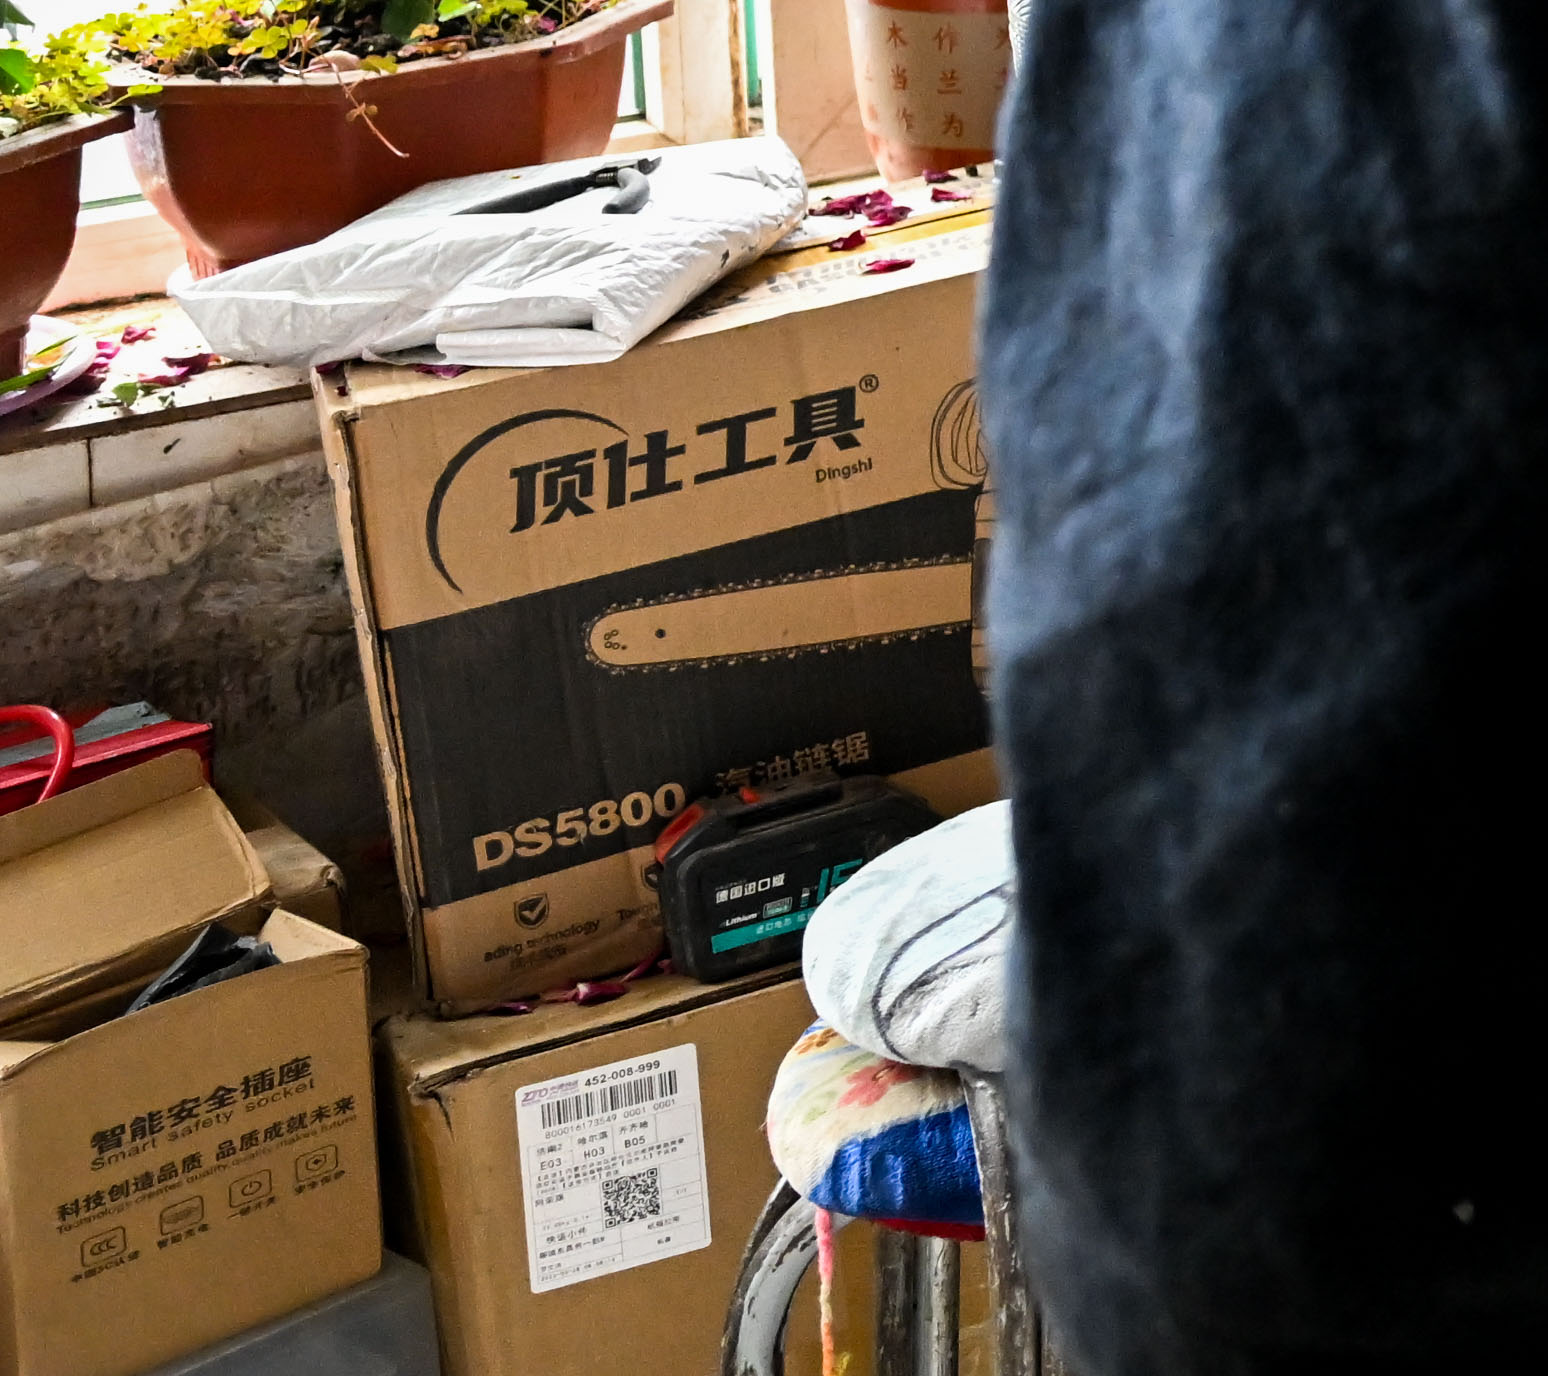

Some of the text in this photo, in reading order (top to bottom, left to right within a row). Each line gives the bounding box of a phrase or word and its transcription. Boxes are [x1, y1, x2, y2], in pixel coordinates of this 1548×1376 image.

[509, 386, 865, 534] 顶仕工具
[472, 781, 686, 873] DS5800
[91, 1055, 312, 1155] 智能安全插座
[585, 1059, 661, 1087] 452-008-999
[57, 1094, 356, 1221] 科技创造品质 品质成就未来
[90, 1077, 316, 1172] Smart safety socket
[583, 1146, 606, 1160] H03
[624, 1135, 646, 1149] B05
